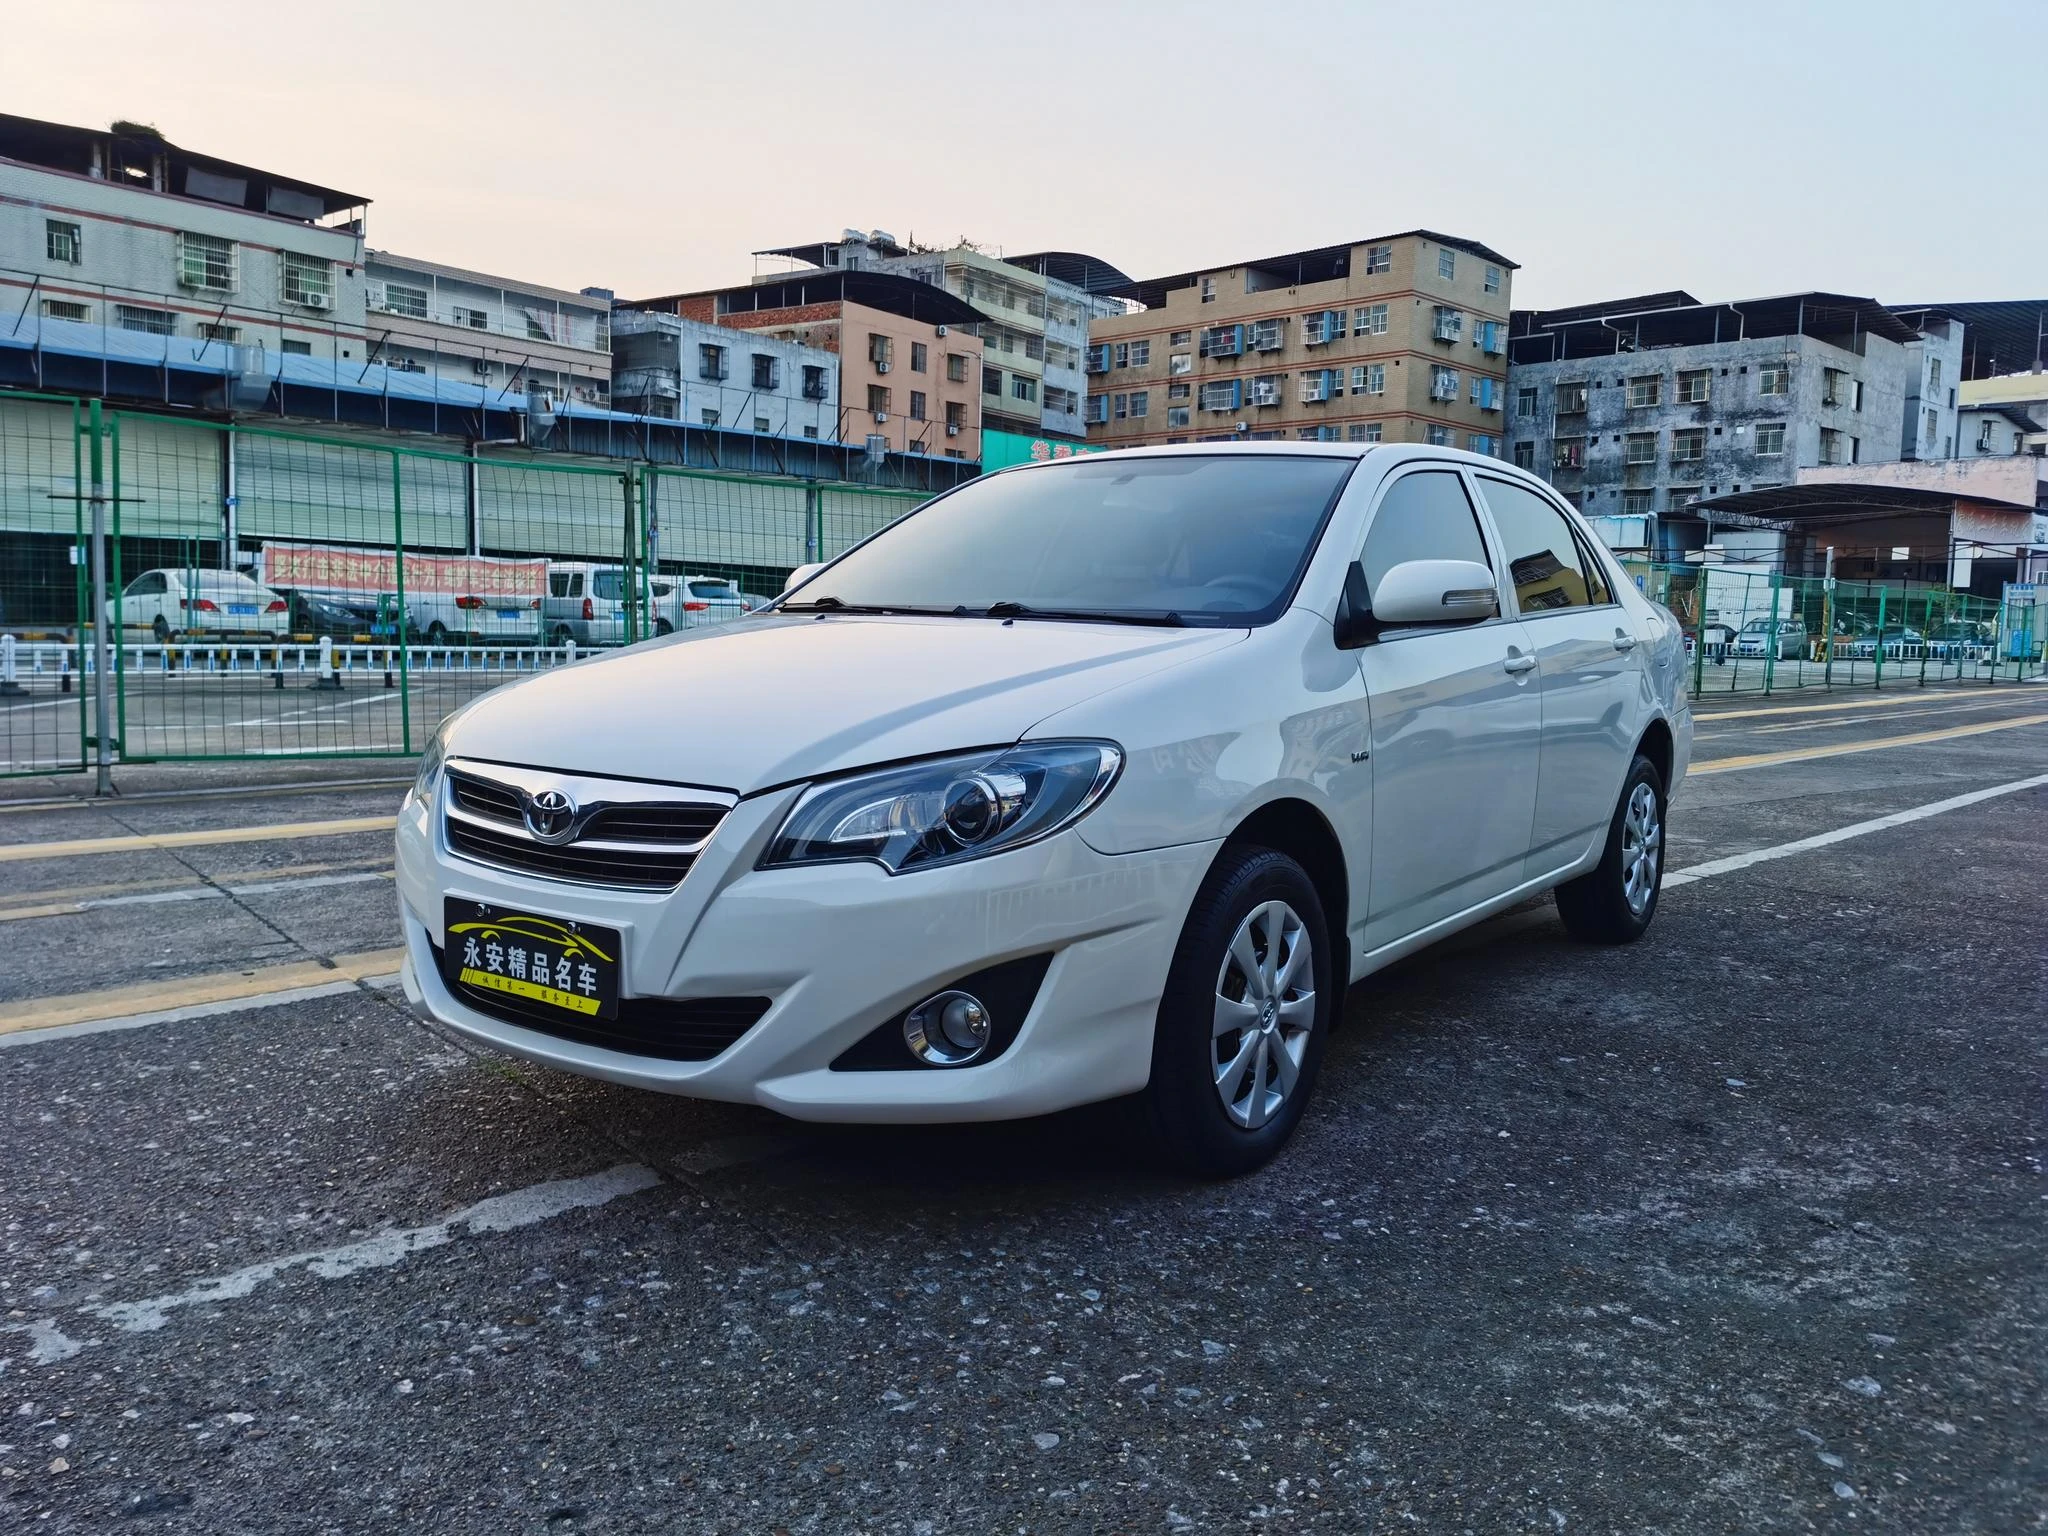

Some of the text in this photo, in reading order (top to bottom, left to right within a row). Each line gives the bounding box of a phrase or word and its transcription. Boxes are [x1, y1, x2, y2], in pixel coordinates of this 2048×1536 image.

[464, 937, 597, 996] 永安精品名车
[481, 975, 526, 992] 诚信第一
